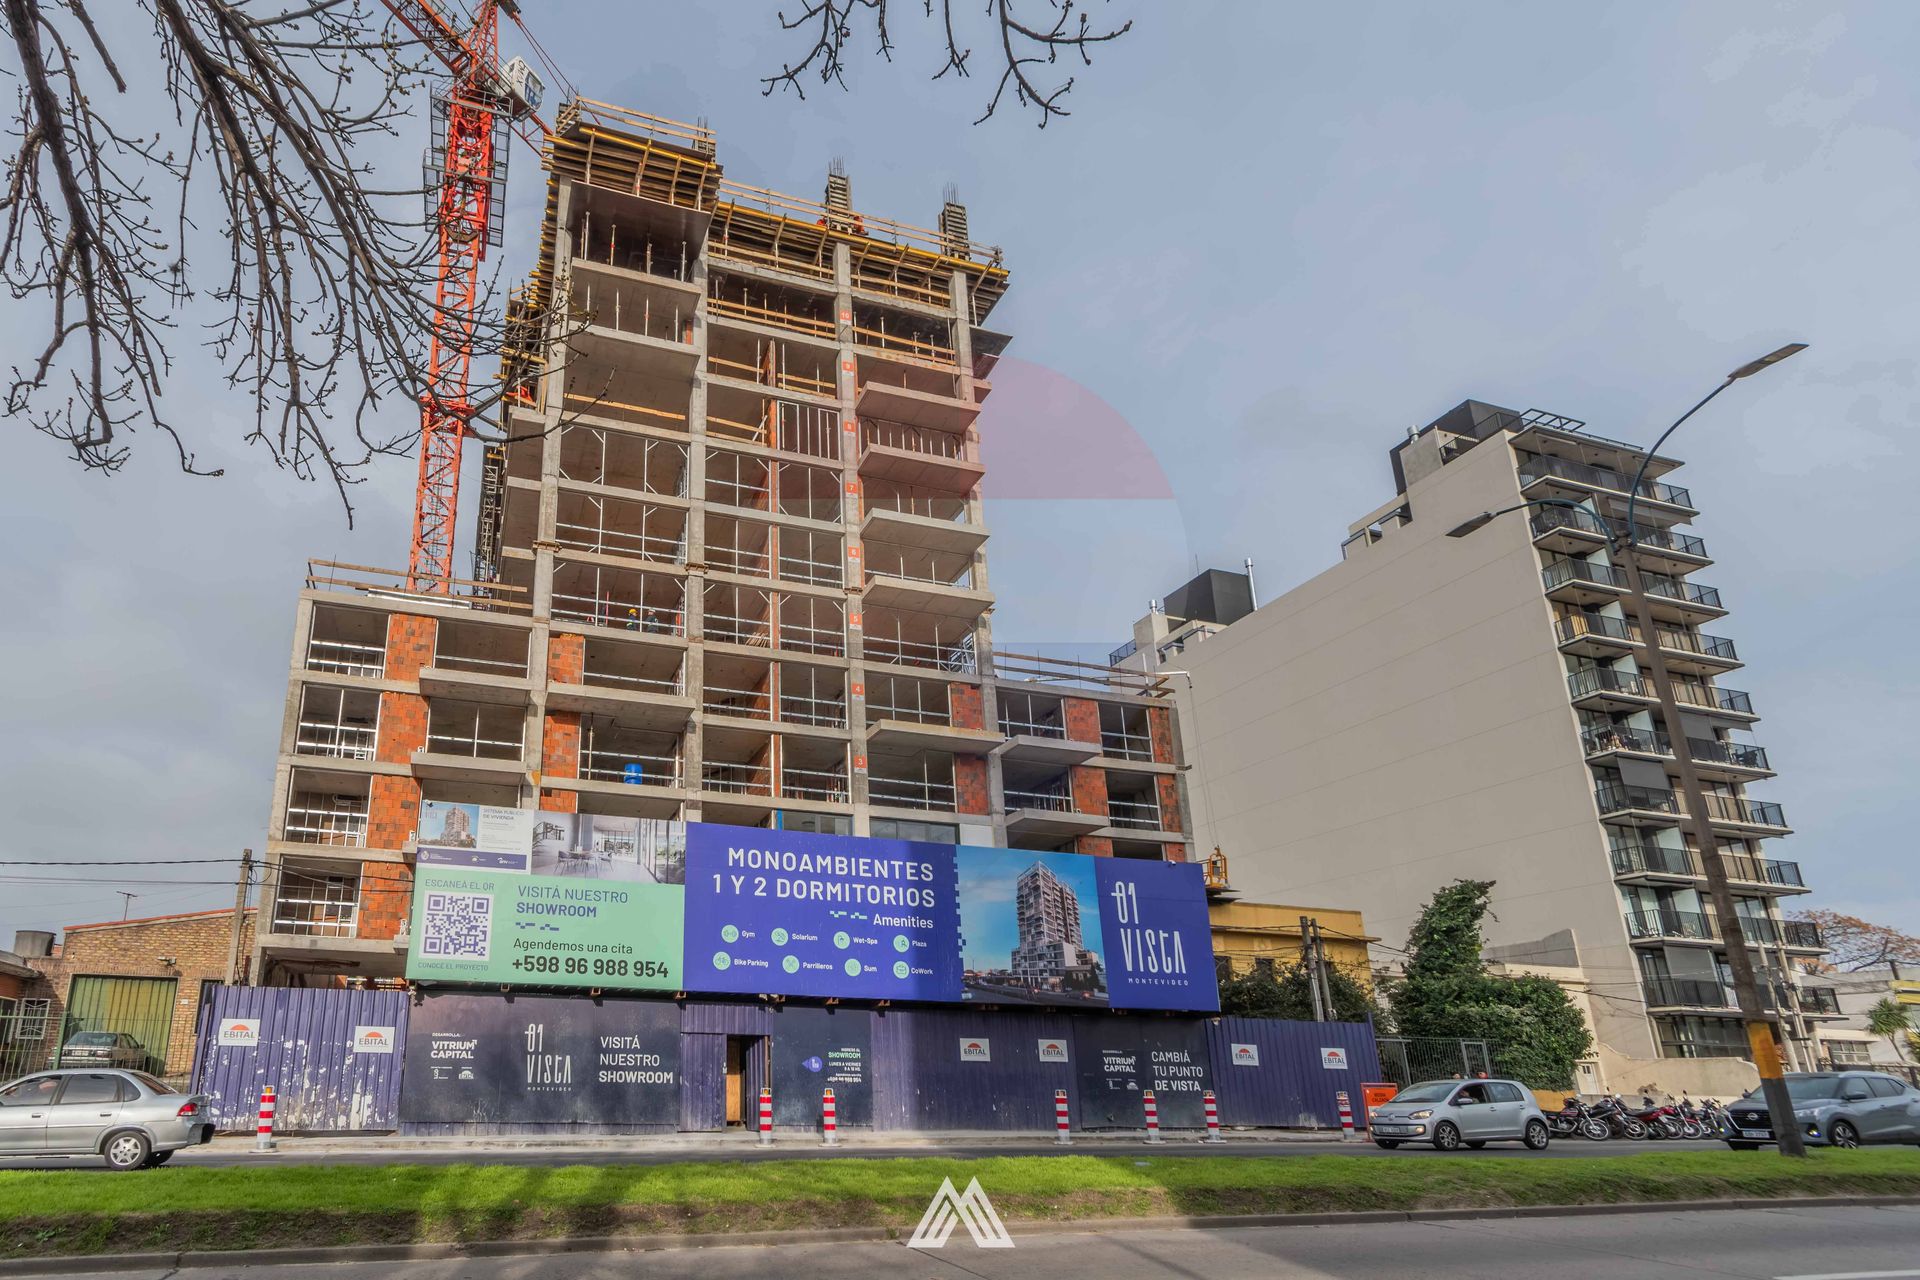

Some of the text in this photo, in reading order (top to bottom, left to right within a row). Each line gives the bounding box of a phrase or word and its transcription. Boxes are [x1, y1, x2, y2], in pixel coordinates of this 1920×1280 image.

[728, 847, 934, 882] MONOAMBIENTES
[469, 881, 479, 890] EL
[483, 882, 494, 891] QR
[712, 873, 935, 908] 1 Y 2 DORMITORIOS
[518, 885, 628, 904] VISITÁ NUESTRO
[516, 903, 596, 917] SHOWROOM
[873, 913, 934, 929] Amenities
[792, 933, 818, 942] Solarium
[853, 936, 878, 945] Wet-Spa
[513, 938, 632, 954] Agendemos una cita
[912, 940, 927, 948] Plaza
[455, 963, 488, 971] PROYECTO
[512, 955, 668, 978] +598 96 988 954
[747, 959, 769, 968] Parking
[802, 962, 833, 971] Parrilleros
[911, 967, 933, 975] CoWork
[1128, 978, 1189, 986] MONTEVIDEO
[432, 1041, 474, 1050] VITRIUM
[600, 1034, 640, 1049] VISITÁ
[431, 1050, 474, 1058] CAPITAL
[964, 1047, 986, 1057] EBITAL
[1042, 1048, 1065, 1057] EBITAL
[1151, 1050, 1191, 1063] CAMBIÁ
[1234, 1052, 1256, 1061] EBITAL
[600, 1053, 660, 1067] NUESTRO
[1103, 1057, 1135, 1065] VITRIUM
[1324, 1056, 1345, 1065] EBITAL
[1154, 1065, 1203, 1078] TU PUNTO
[599, 1070, 673, 1084] SHOWROOM
[1155, 1080, 1201, 1092] DE VISTA
